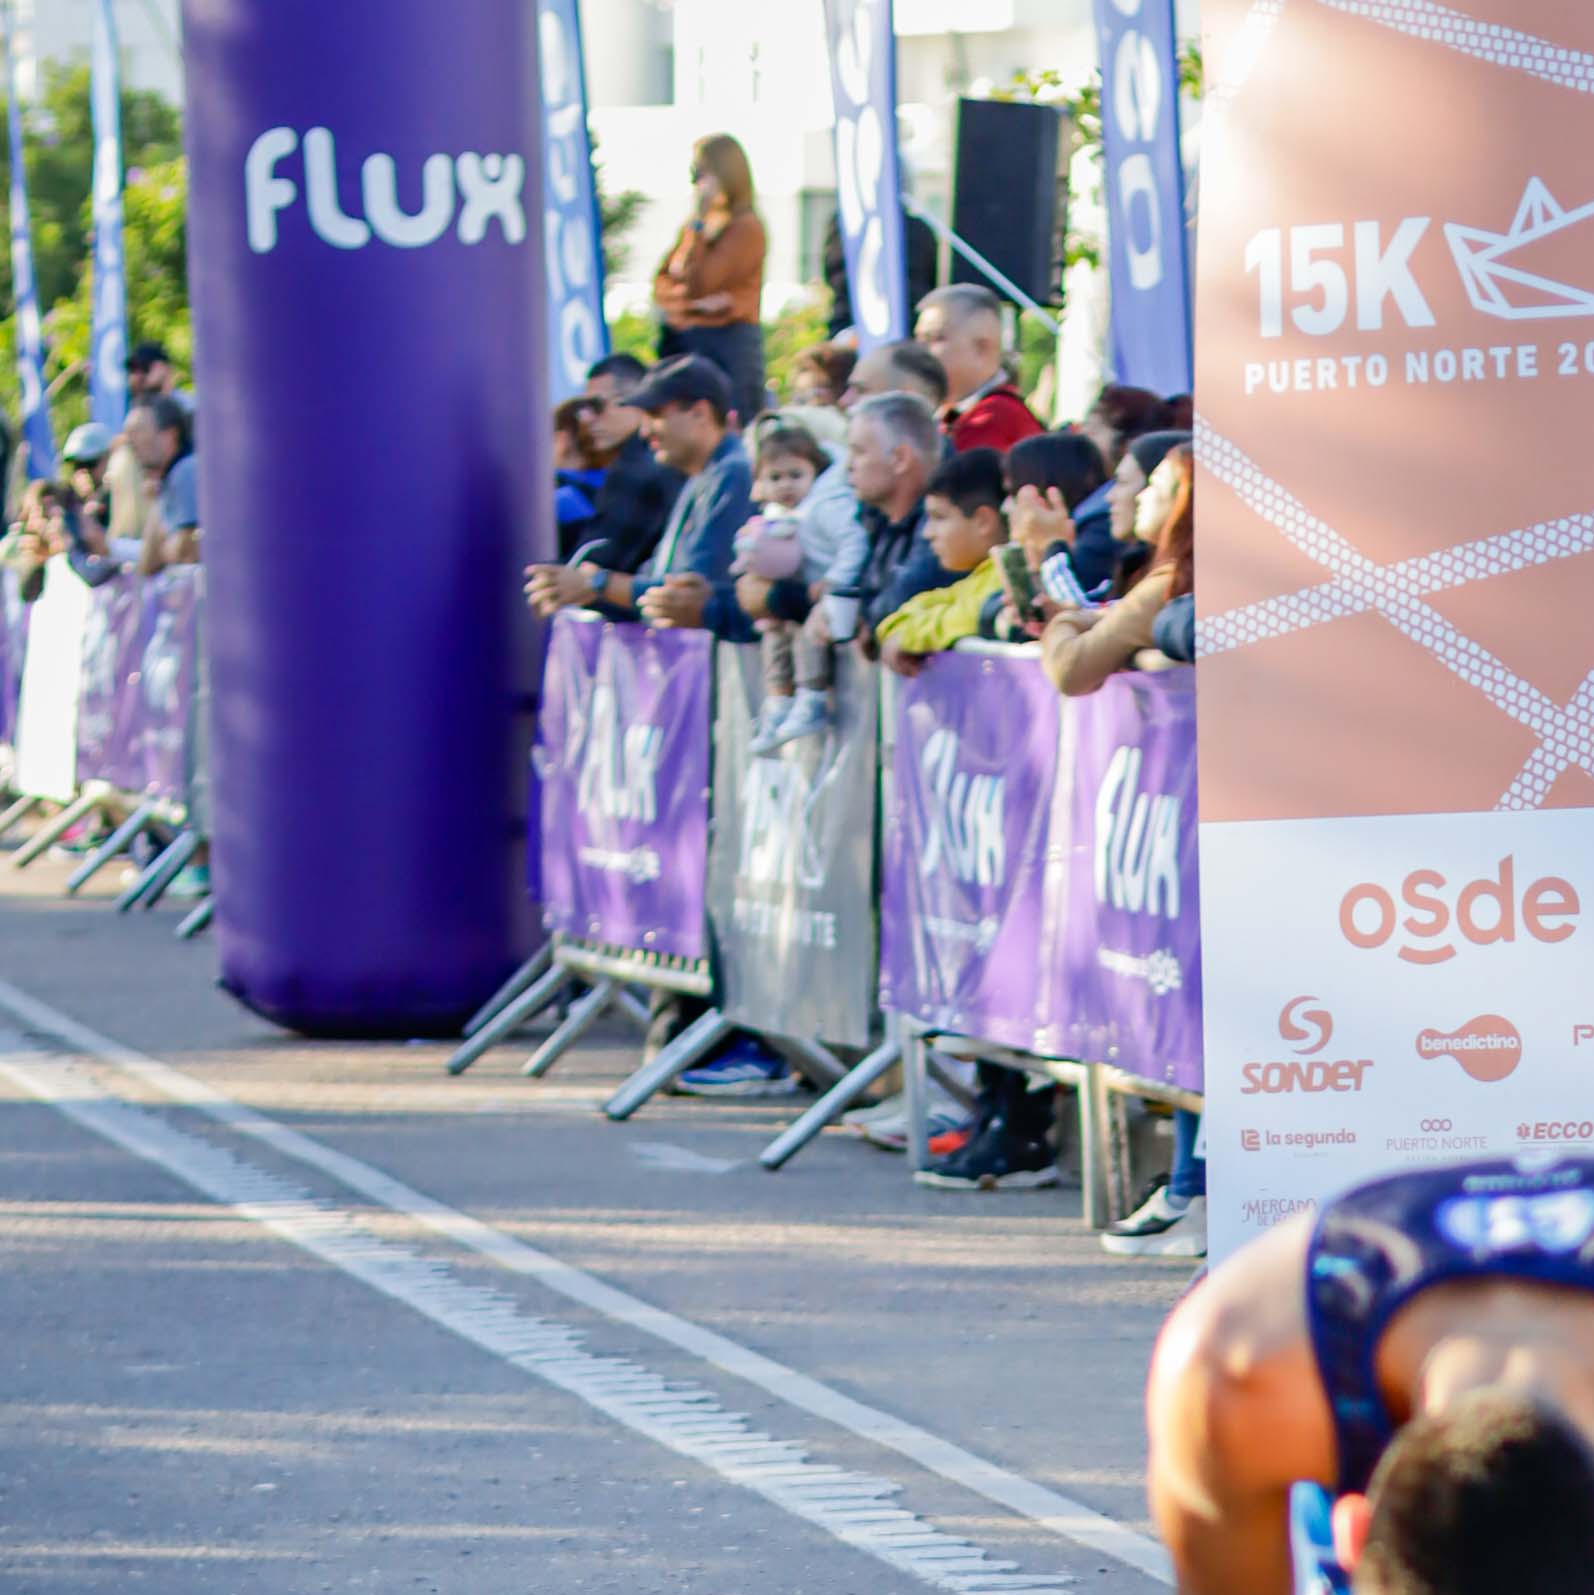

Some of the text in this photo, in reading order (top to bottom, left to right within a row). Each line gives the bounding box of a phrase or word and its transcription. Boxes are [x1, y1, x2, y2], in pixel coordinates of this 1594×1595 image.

[245, 126, 527, 254] flux
[1244, 216, 1436, 338] 15K
[1244, 354, 1389, 395] PUERTO
[1405, 345, 1539, 384] NORTE
[1338, 853, 1581, 950] osde
[1421, 1033, 1519, 1053] benedictino
[1265, 1128, 1357, 1149] la segunda
[1386, 1137, 1488, 1151] PUERTO NORTE
[1533, 1121, 1594, 1140] ECCO
